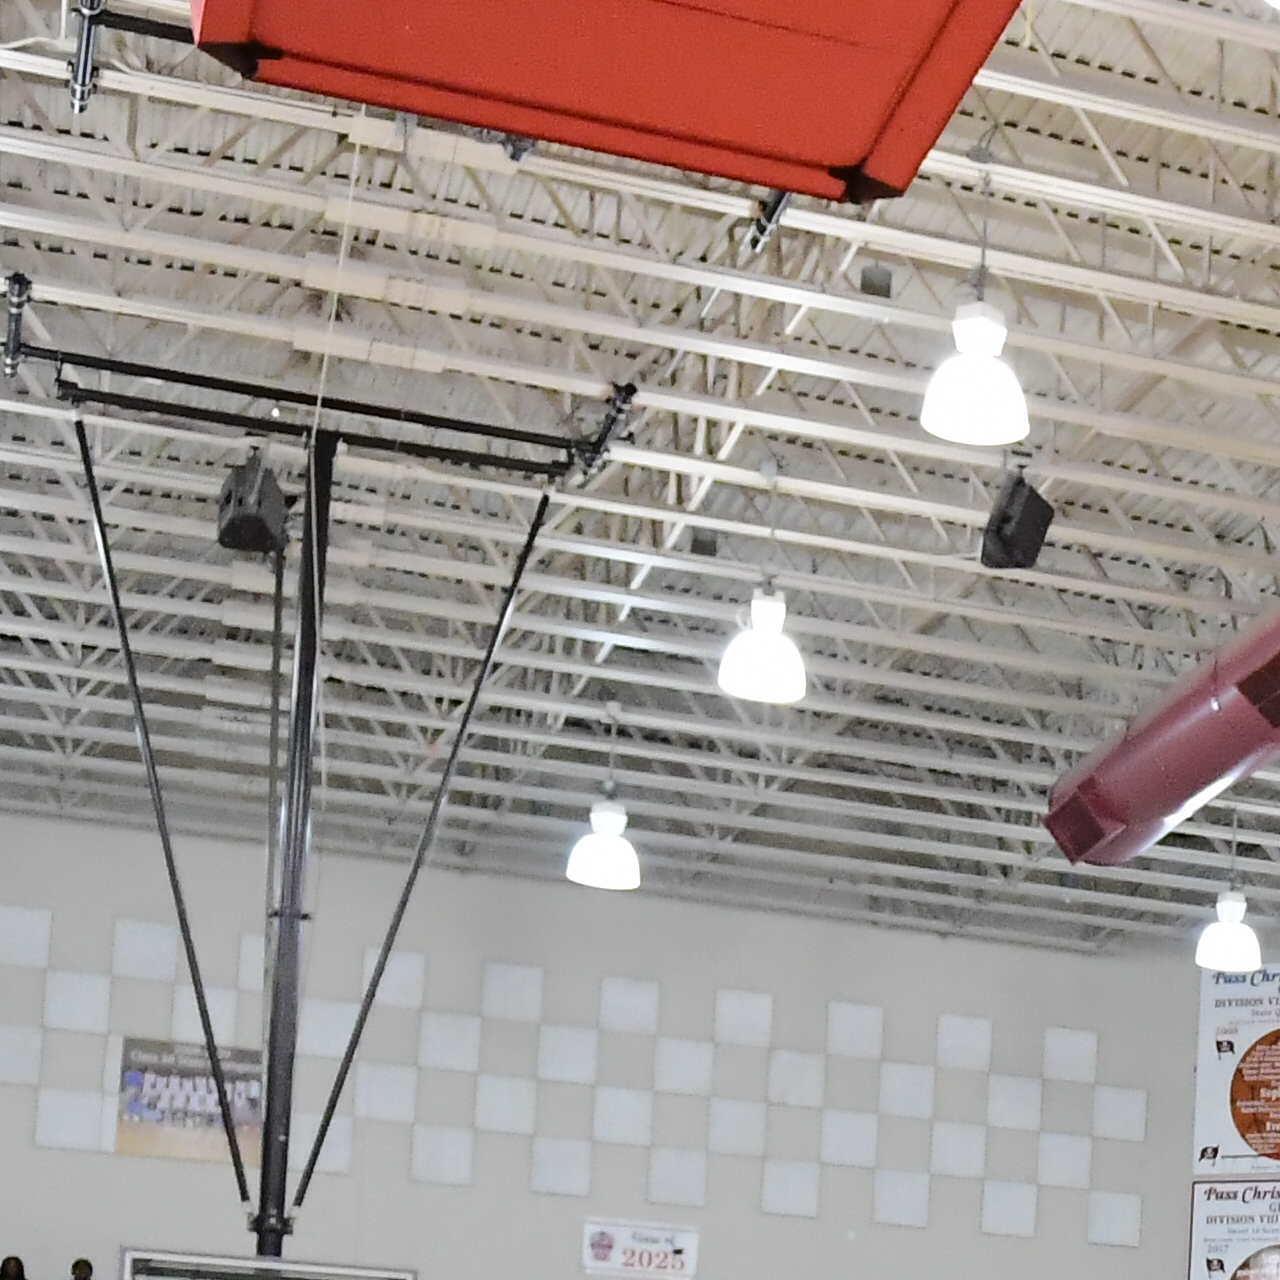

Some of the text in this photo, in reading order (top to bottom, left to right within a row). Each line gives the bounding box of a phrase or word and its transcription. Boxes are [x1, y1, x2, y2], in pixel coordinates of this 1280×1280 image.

[1213, 972, 1247, 985] Pass
[1215, 996, 1263, 1008] DIVISION
[1204, 1187, 1238, 1201] Pass
[1206, 1214, 1255, 1225] DIVISION
[1259, 1214, 1279, 1224] VIII
[623, 1248, 685, 1270] 2025
